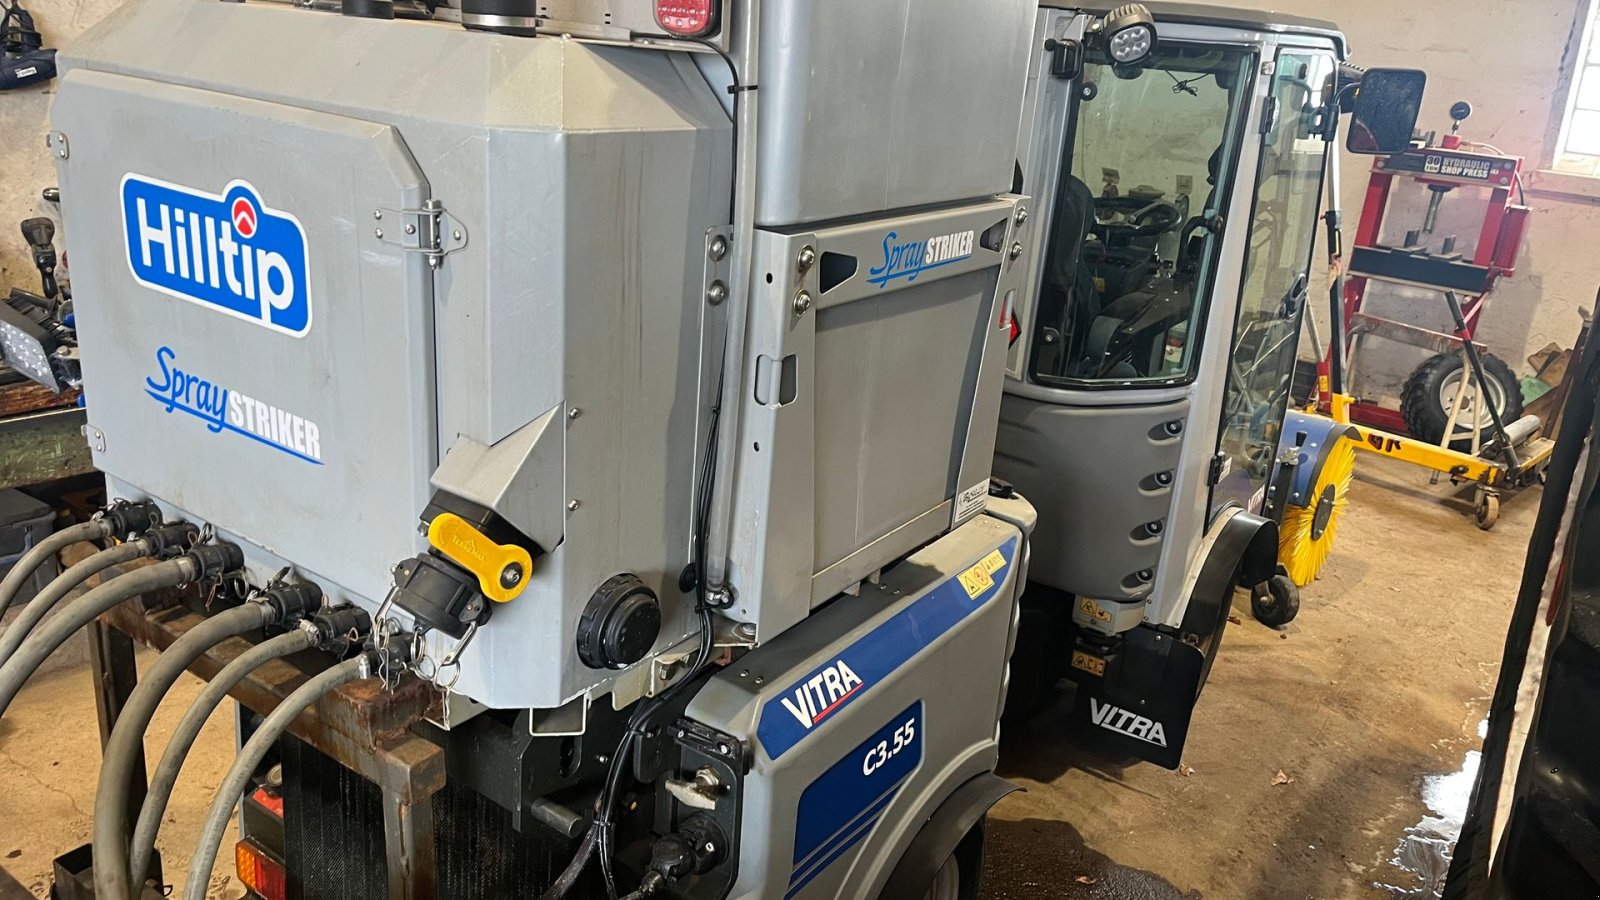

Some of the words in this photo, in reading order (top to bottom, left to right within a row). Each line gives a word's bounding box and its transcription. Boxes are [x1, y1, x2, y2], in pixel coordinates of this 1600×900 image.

[1427, 156, 1440, 165] 30
[1440, 165, 1463, 175] SHOP
[1462, 168, 1488, 178] PRESS
[1442, 157, 1490, 170] HYDRAULIC
[137, 197, 294, 324] Hilltip
[780, 659, 863, 729] VITRA
[862, 717, 915, 776] C3.55
[1090, 697, 1167, 747] VITRA
